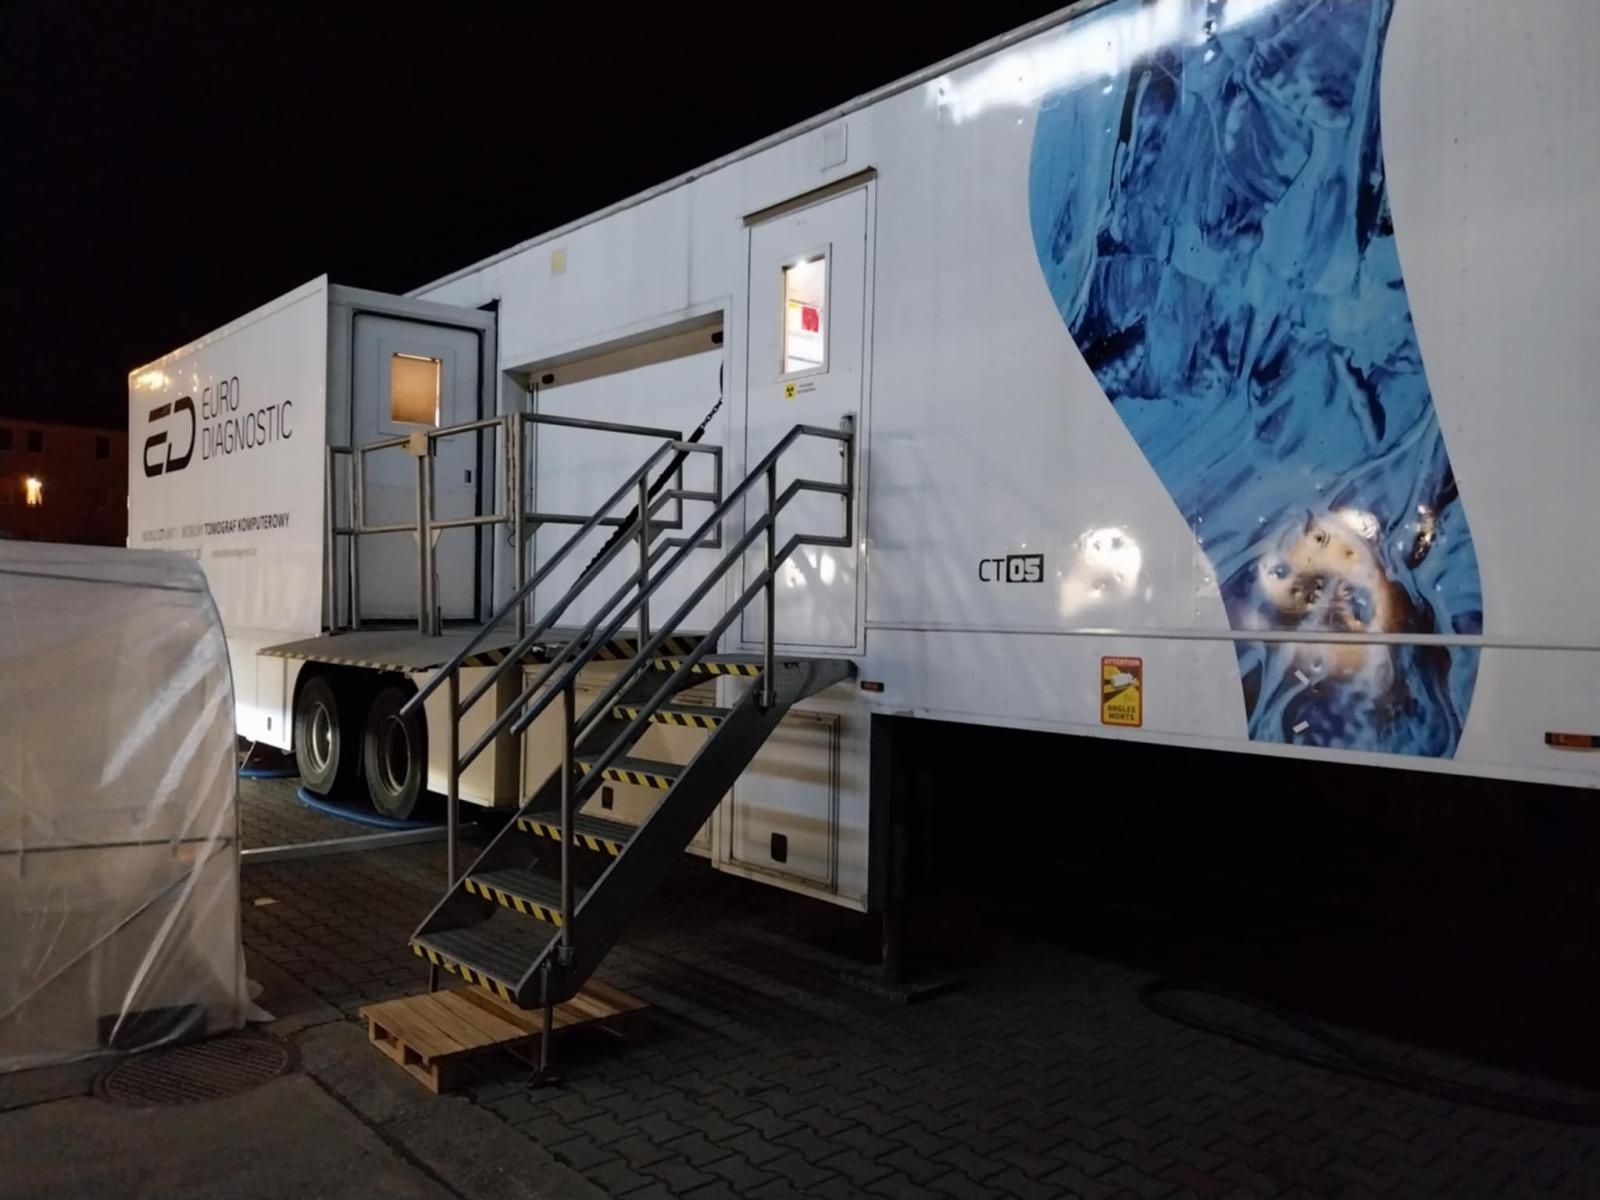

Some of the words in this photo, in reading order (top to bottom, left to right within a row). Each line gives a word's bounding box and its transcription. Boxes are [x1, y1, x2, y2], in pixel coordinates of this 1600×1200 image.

[202, 376, 240, 420] EURO
[202, 400, 293, 460] DIAGNOSTIC
[204, 519, 237, 535] TOMOGRAF
[238, 512, 290, 532] KOMPUTEROWY
[1107, 704, 1136, 713] ANGLES
[1108, 711, 1135, 721] MORTS
